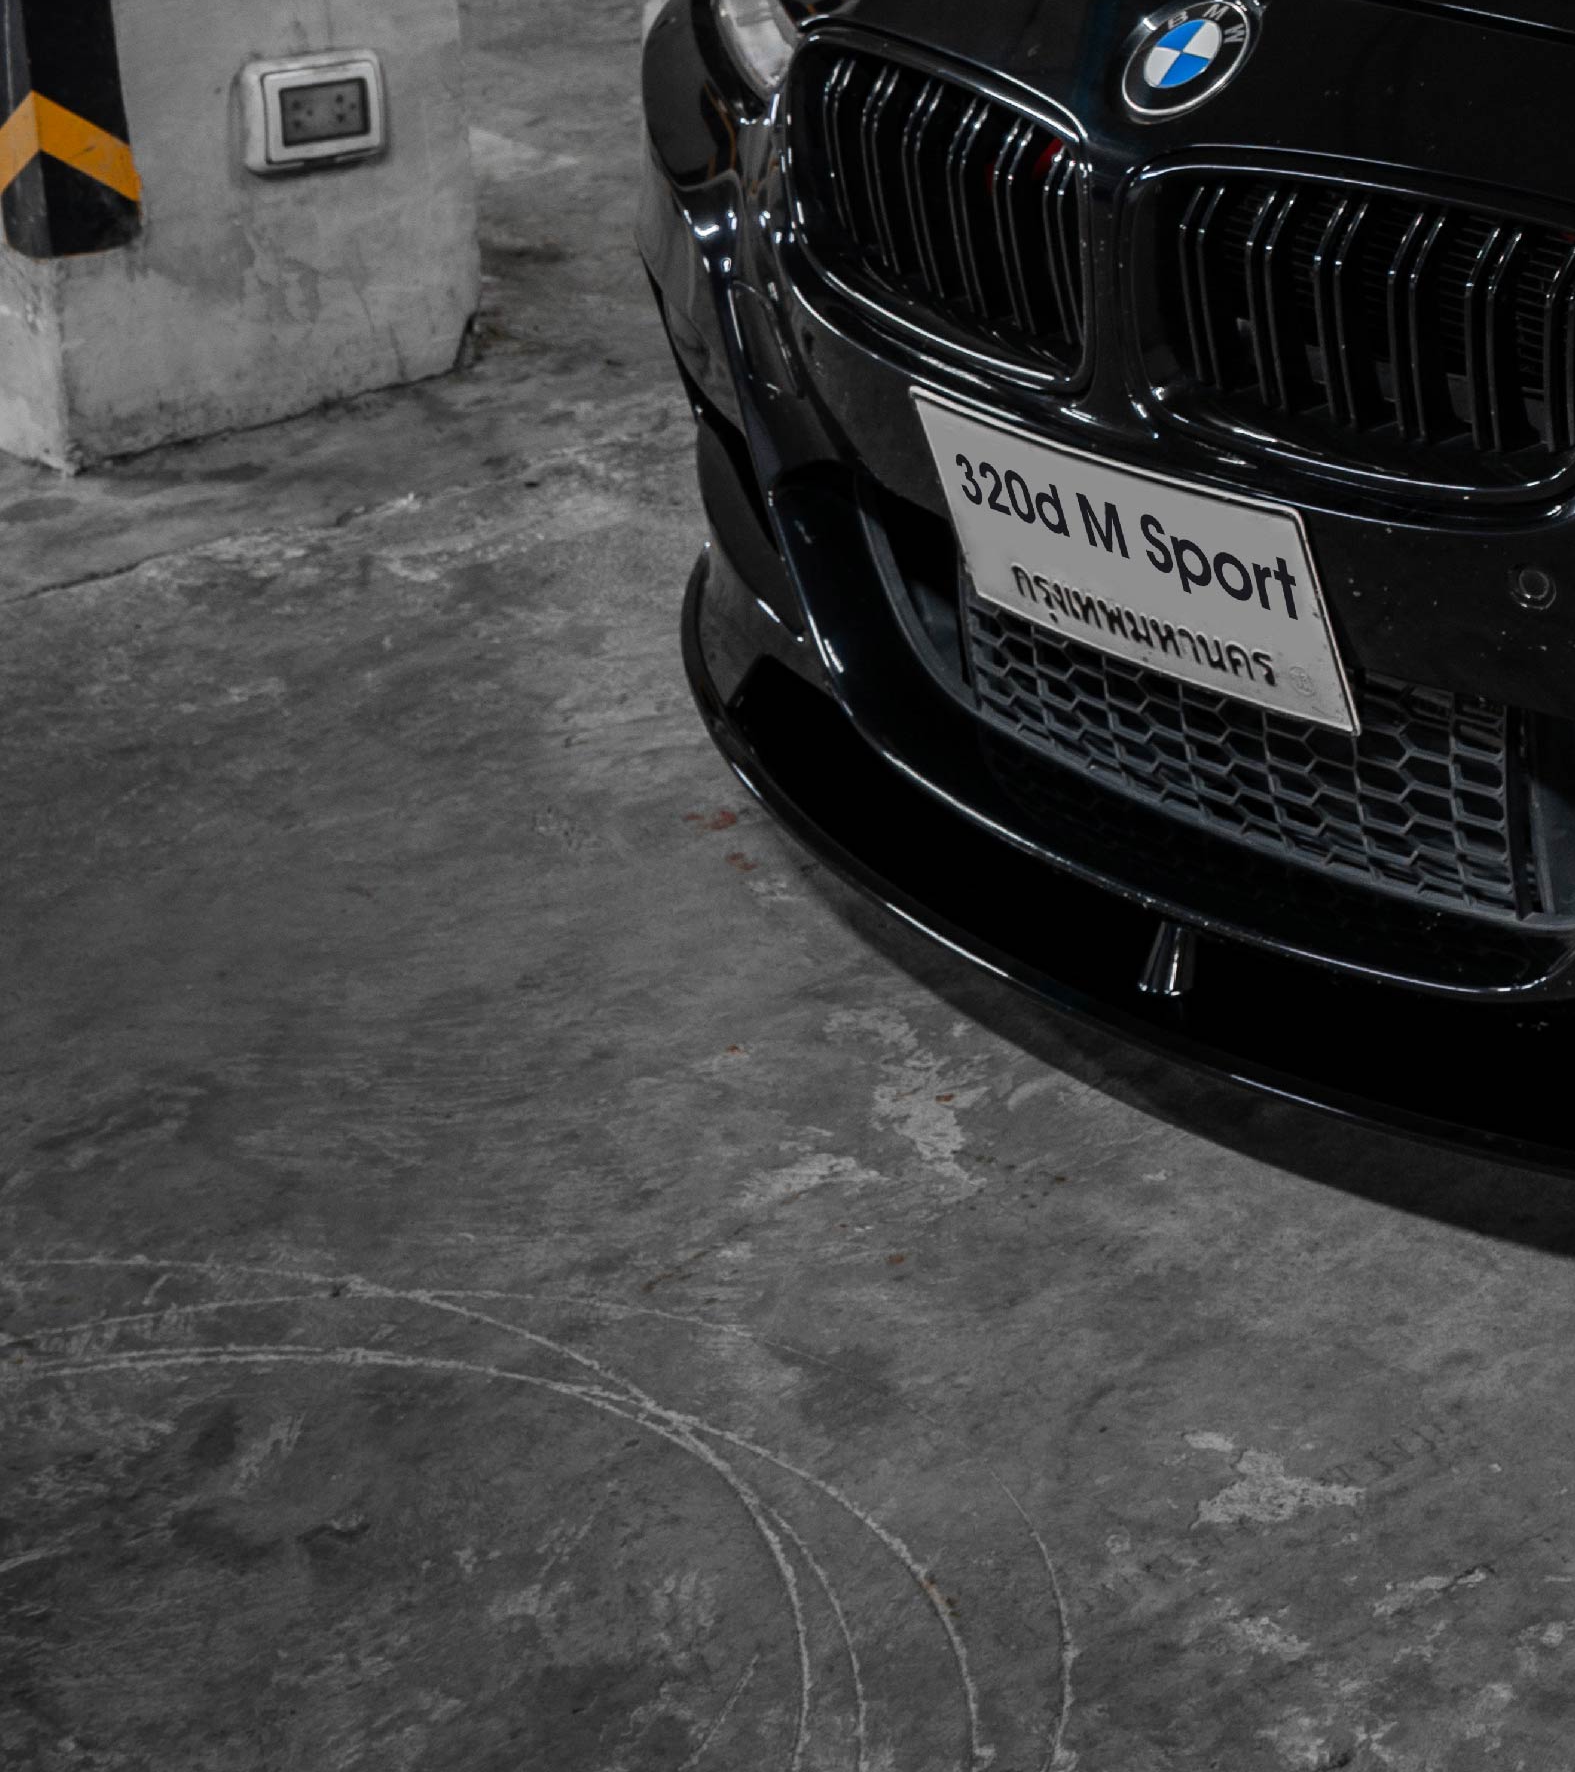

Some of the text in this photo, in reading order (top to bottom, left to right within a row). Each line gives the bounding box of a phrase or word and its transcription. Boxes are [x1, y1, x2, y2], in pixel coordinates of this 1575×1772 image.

[1167, 3, 1245, 44] BMW
[955, 453, 1299, 621] 320d M Sport
[1011, 565, 1279, 688] กรุงเทพมหานคร
